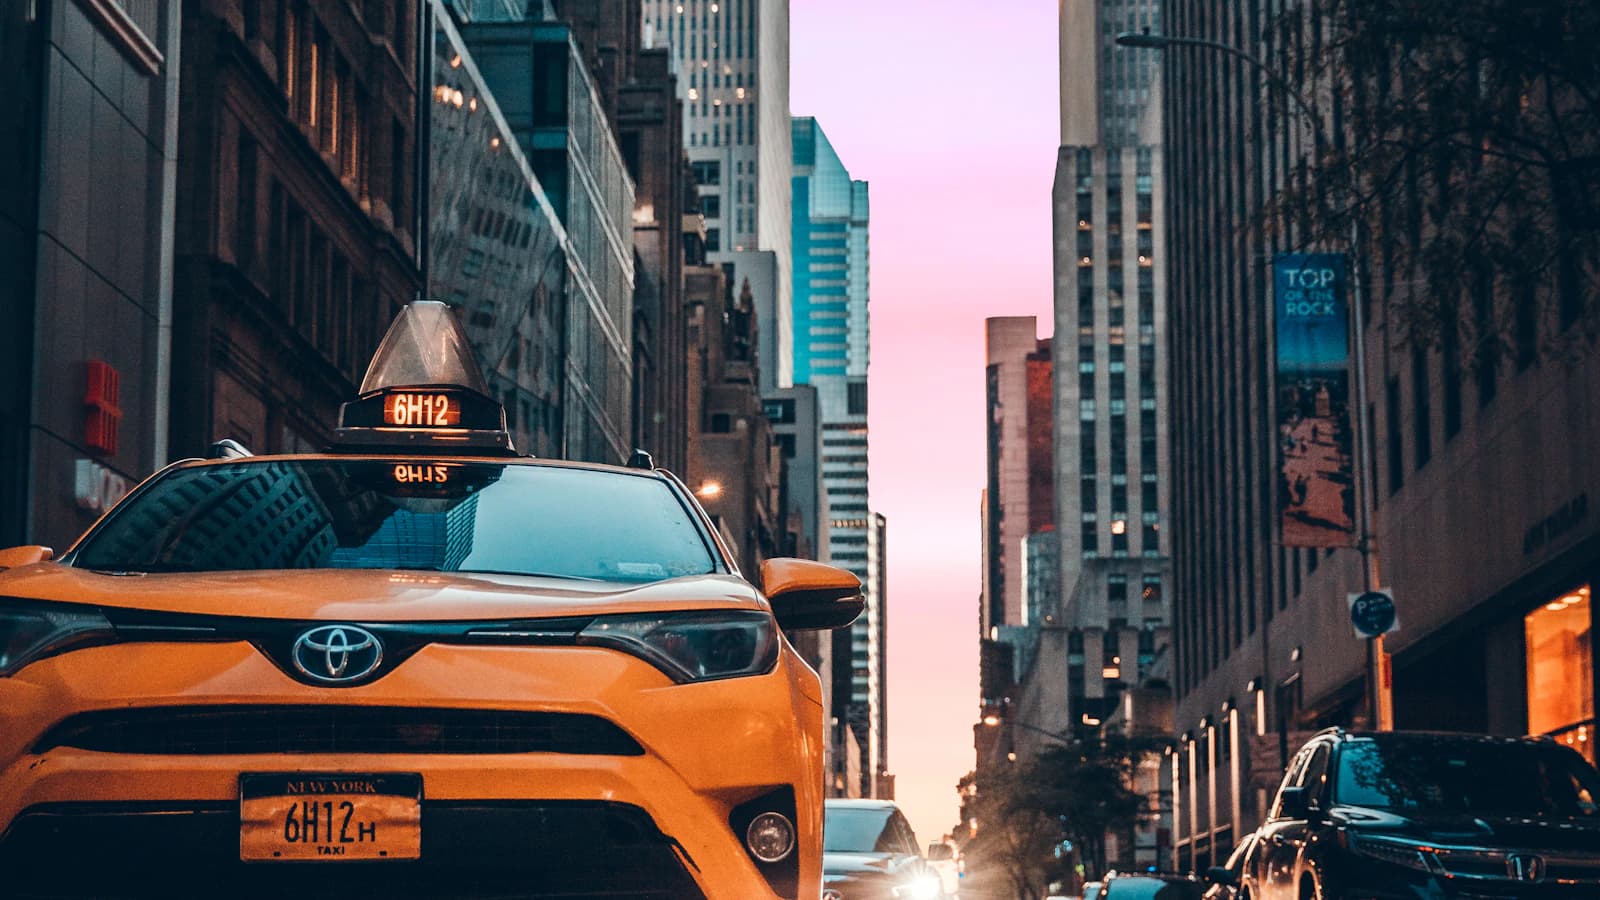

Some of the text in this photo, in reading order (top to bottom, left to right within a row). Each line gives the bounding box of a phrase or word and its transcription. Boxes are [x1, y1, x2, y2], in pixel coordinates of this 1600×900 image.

[1283, 268, 1335, 289] TOP
[1285, 301, 1335, 316] ROCK
[393, 393, 449, 425] 6H12
[287, 780, 376, 794] NEW YORK
[317, 845, 345, 855] TAXI
